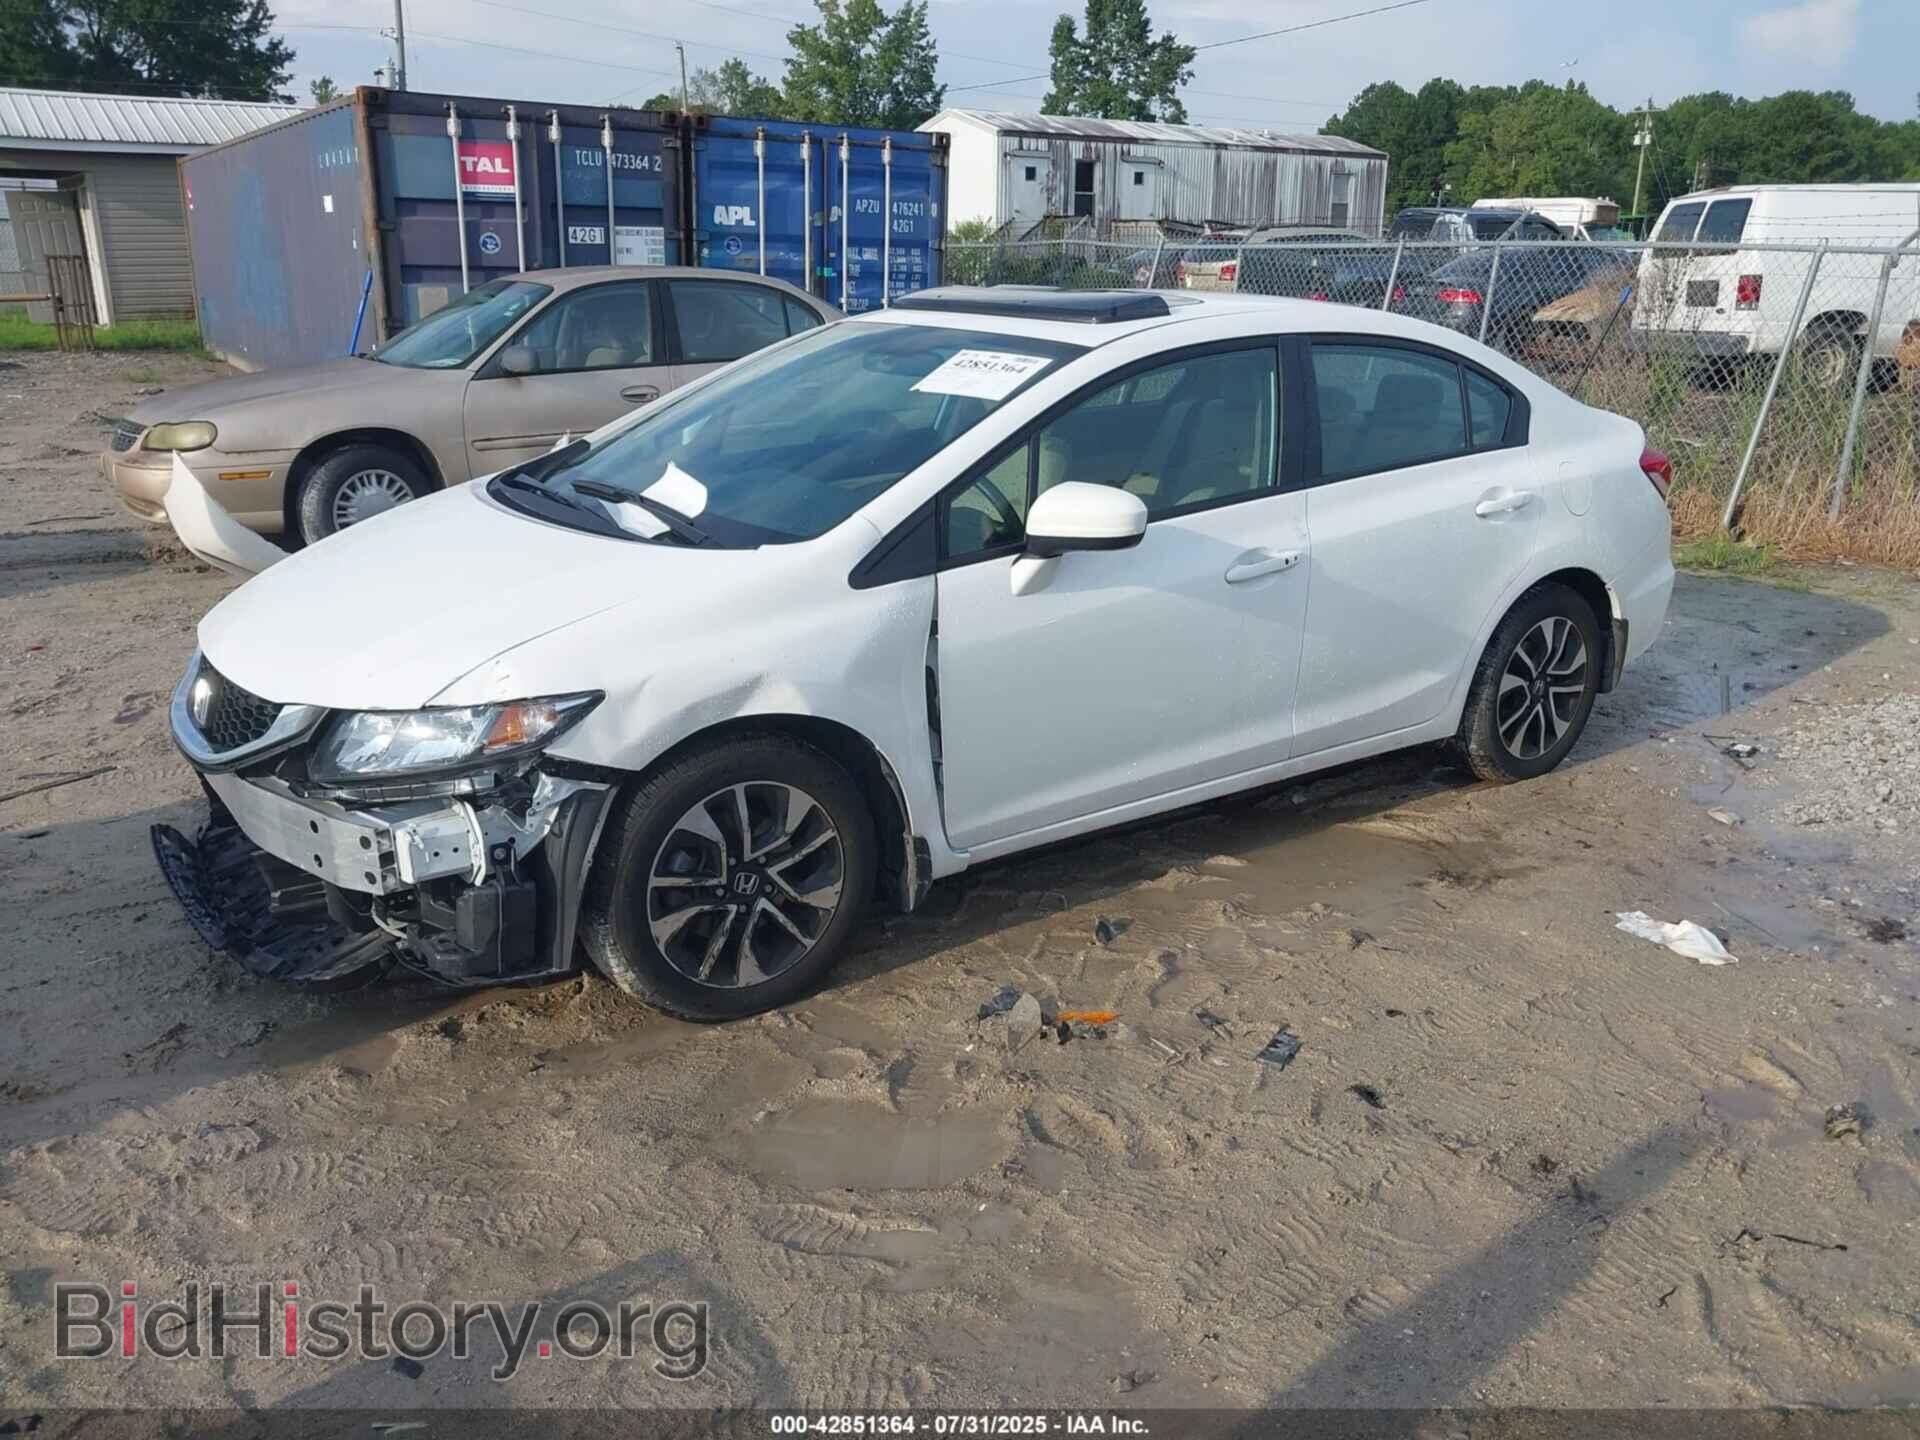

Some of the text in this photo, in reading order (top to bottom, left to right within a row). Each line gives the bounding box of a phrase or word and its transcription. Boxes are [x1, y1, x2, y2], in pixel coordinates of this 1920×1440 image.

[460, 156, 510, 173] TAL
[576, 150, 602, 166] TCLU
[713, 205, 756, 226] APL
[856, 199, 880, 213] APZU
[893, 201, 924, 217] 476241
[893, 219, 914, 233] 42G1
[569, 228, 604, 244] 42G1
